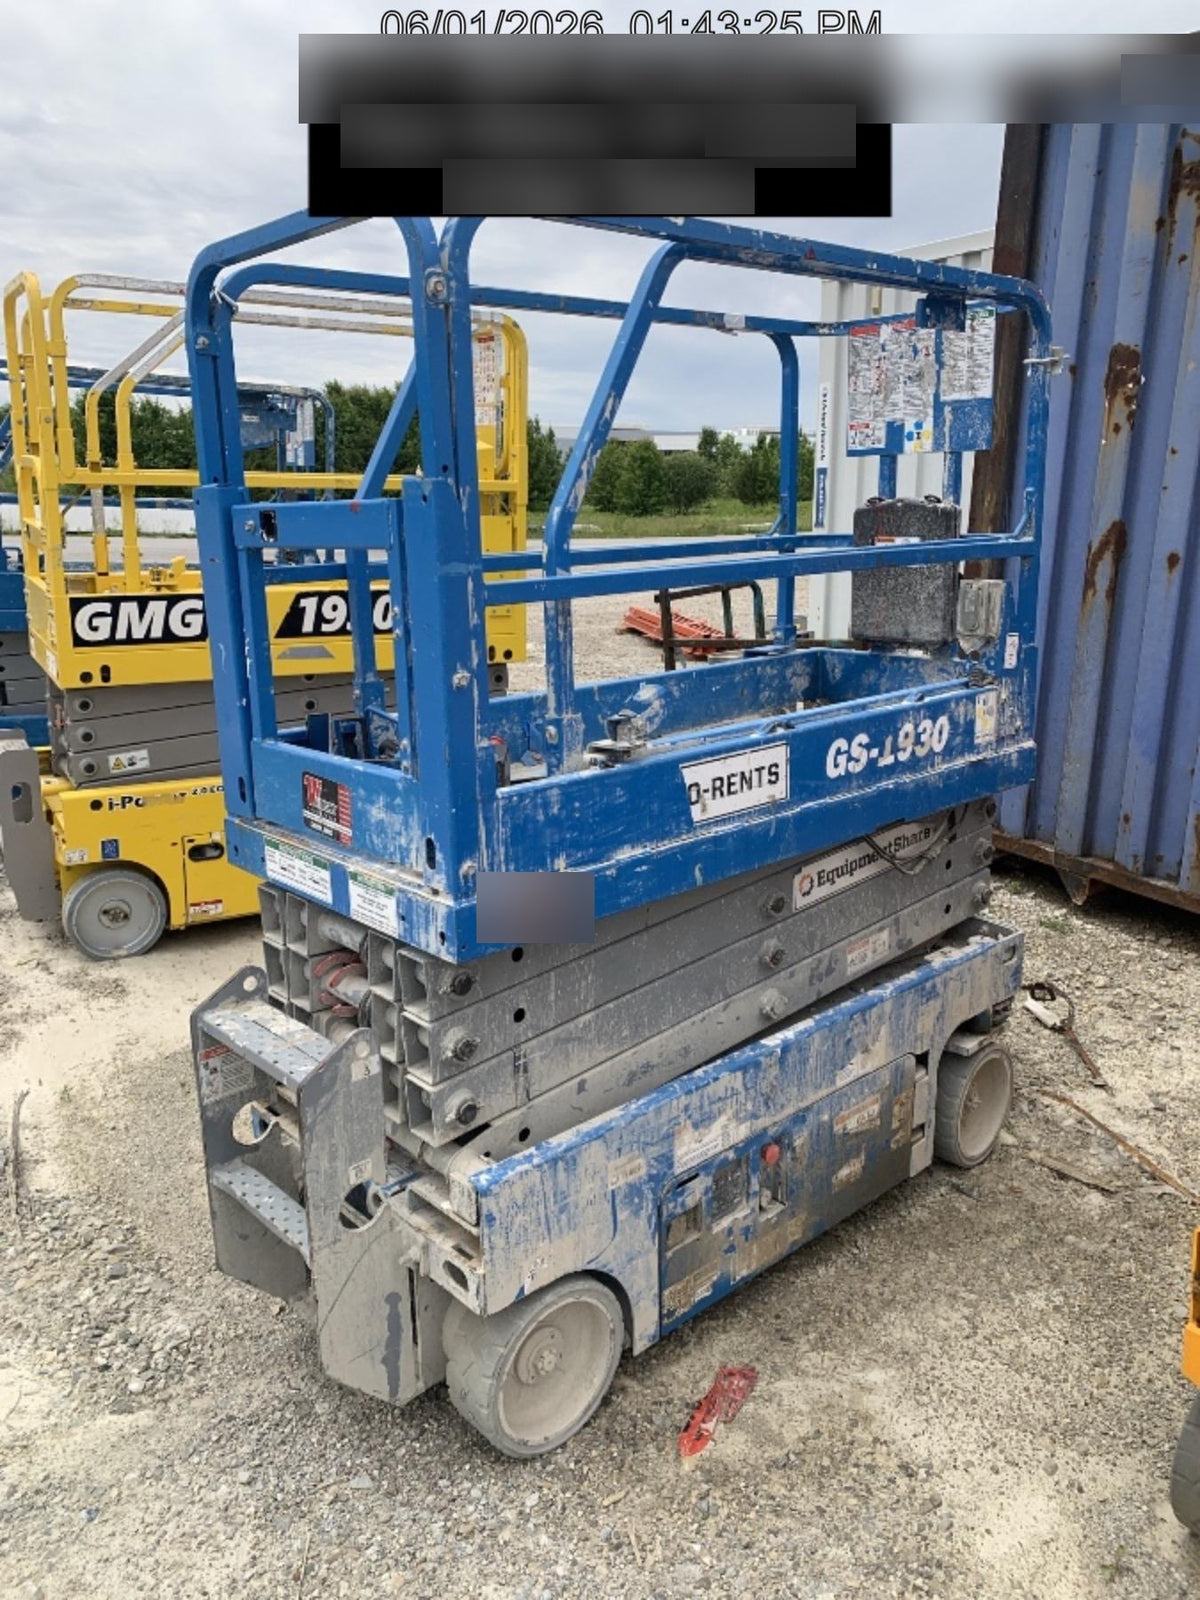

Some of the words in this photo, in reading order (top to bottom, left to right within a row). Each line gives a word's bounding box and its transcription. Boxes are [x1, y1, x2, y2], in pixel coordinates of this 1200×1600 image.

[73, 598, 204, 642] GMG
[298, 594, 394, 634] 190
[826, 714, 950, 779] GS-1930
